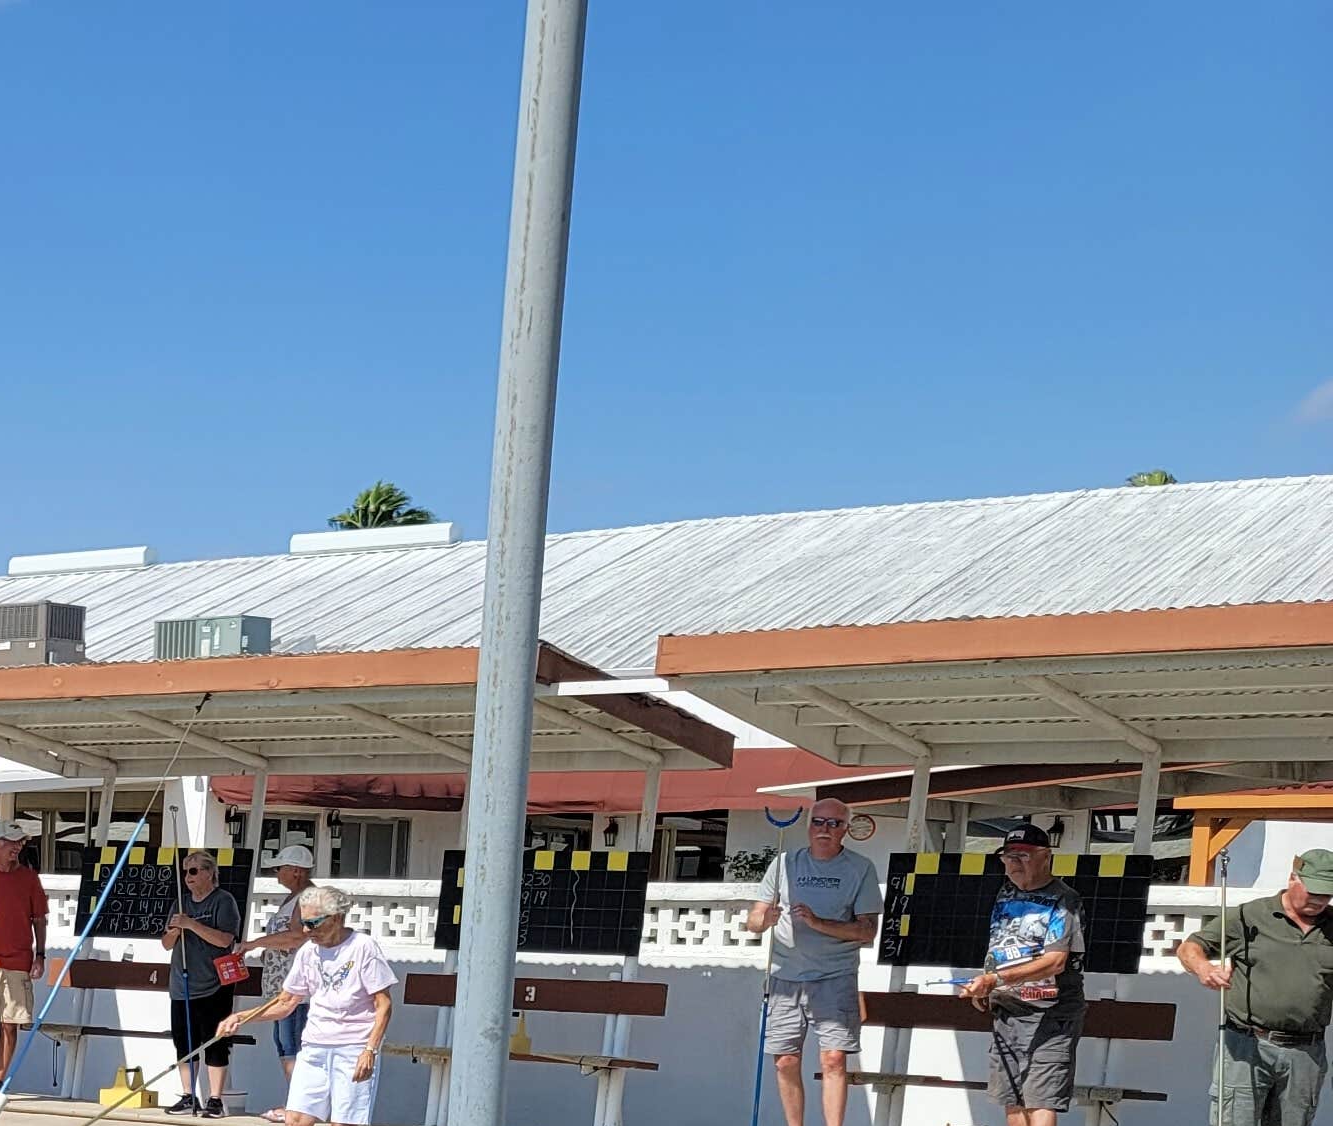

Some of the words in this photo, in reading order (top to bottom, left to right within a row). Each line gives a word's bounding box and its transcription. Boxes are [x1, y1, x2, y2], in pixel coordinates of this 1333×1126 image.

[533, 891, 548, 906] 19
[891, 896, 910, 913] 19
[884, 938, 902, 957] 31
[149, 970, 158, 984] 4
[524, 986, 536, 1002] 3
